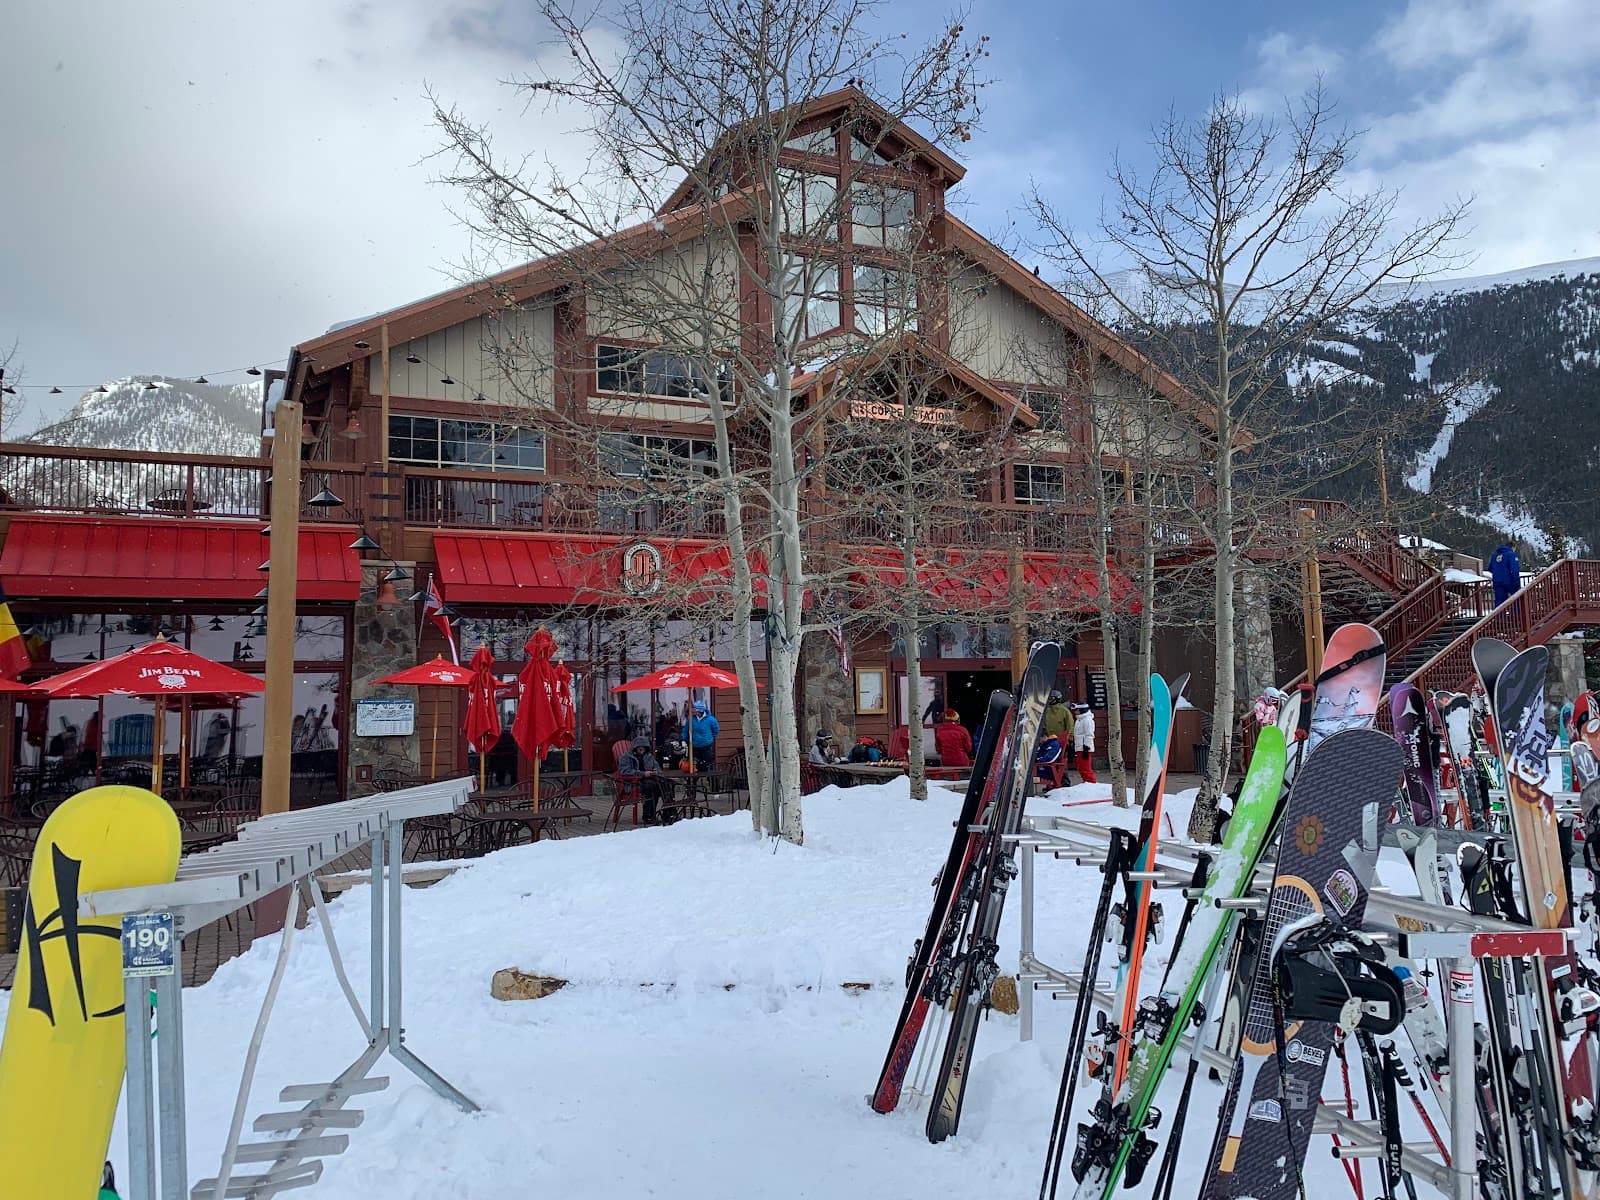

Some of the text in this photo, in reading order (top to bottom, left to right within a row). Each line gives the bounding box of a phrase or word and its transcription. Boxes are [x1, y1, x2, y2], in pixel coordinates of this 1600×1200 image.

[871, 405, 909, 420] COPPE
[138, 666, 201, 679] JIM BEAM
[1408, 733, 1421, 768] ATOMIC
[126, 927, 169, 948] 190
[1492, 956, 1502, 979] FIS
[1303, 1046, 1325, 1059] BEVEL
